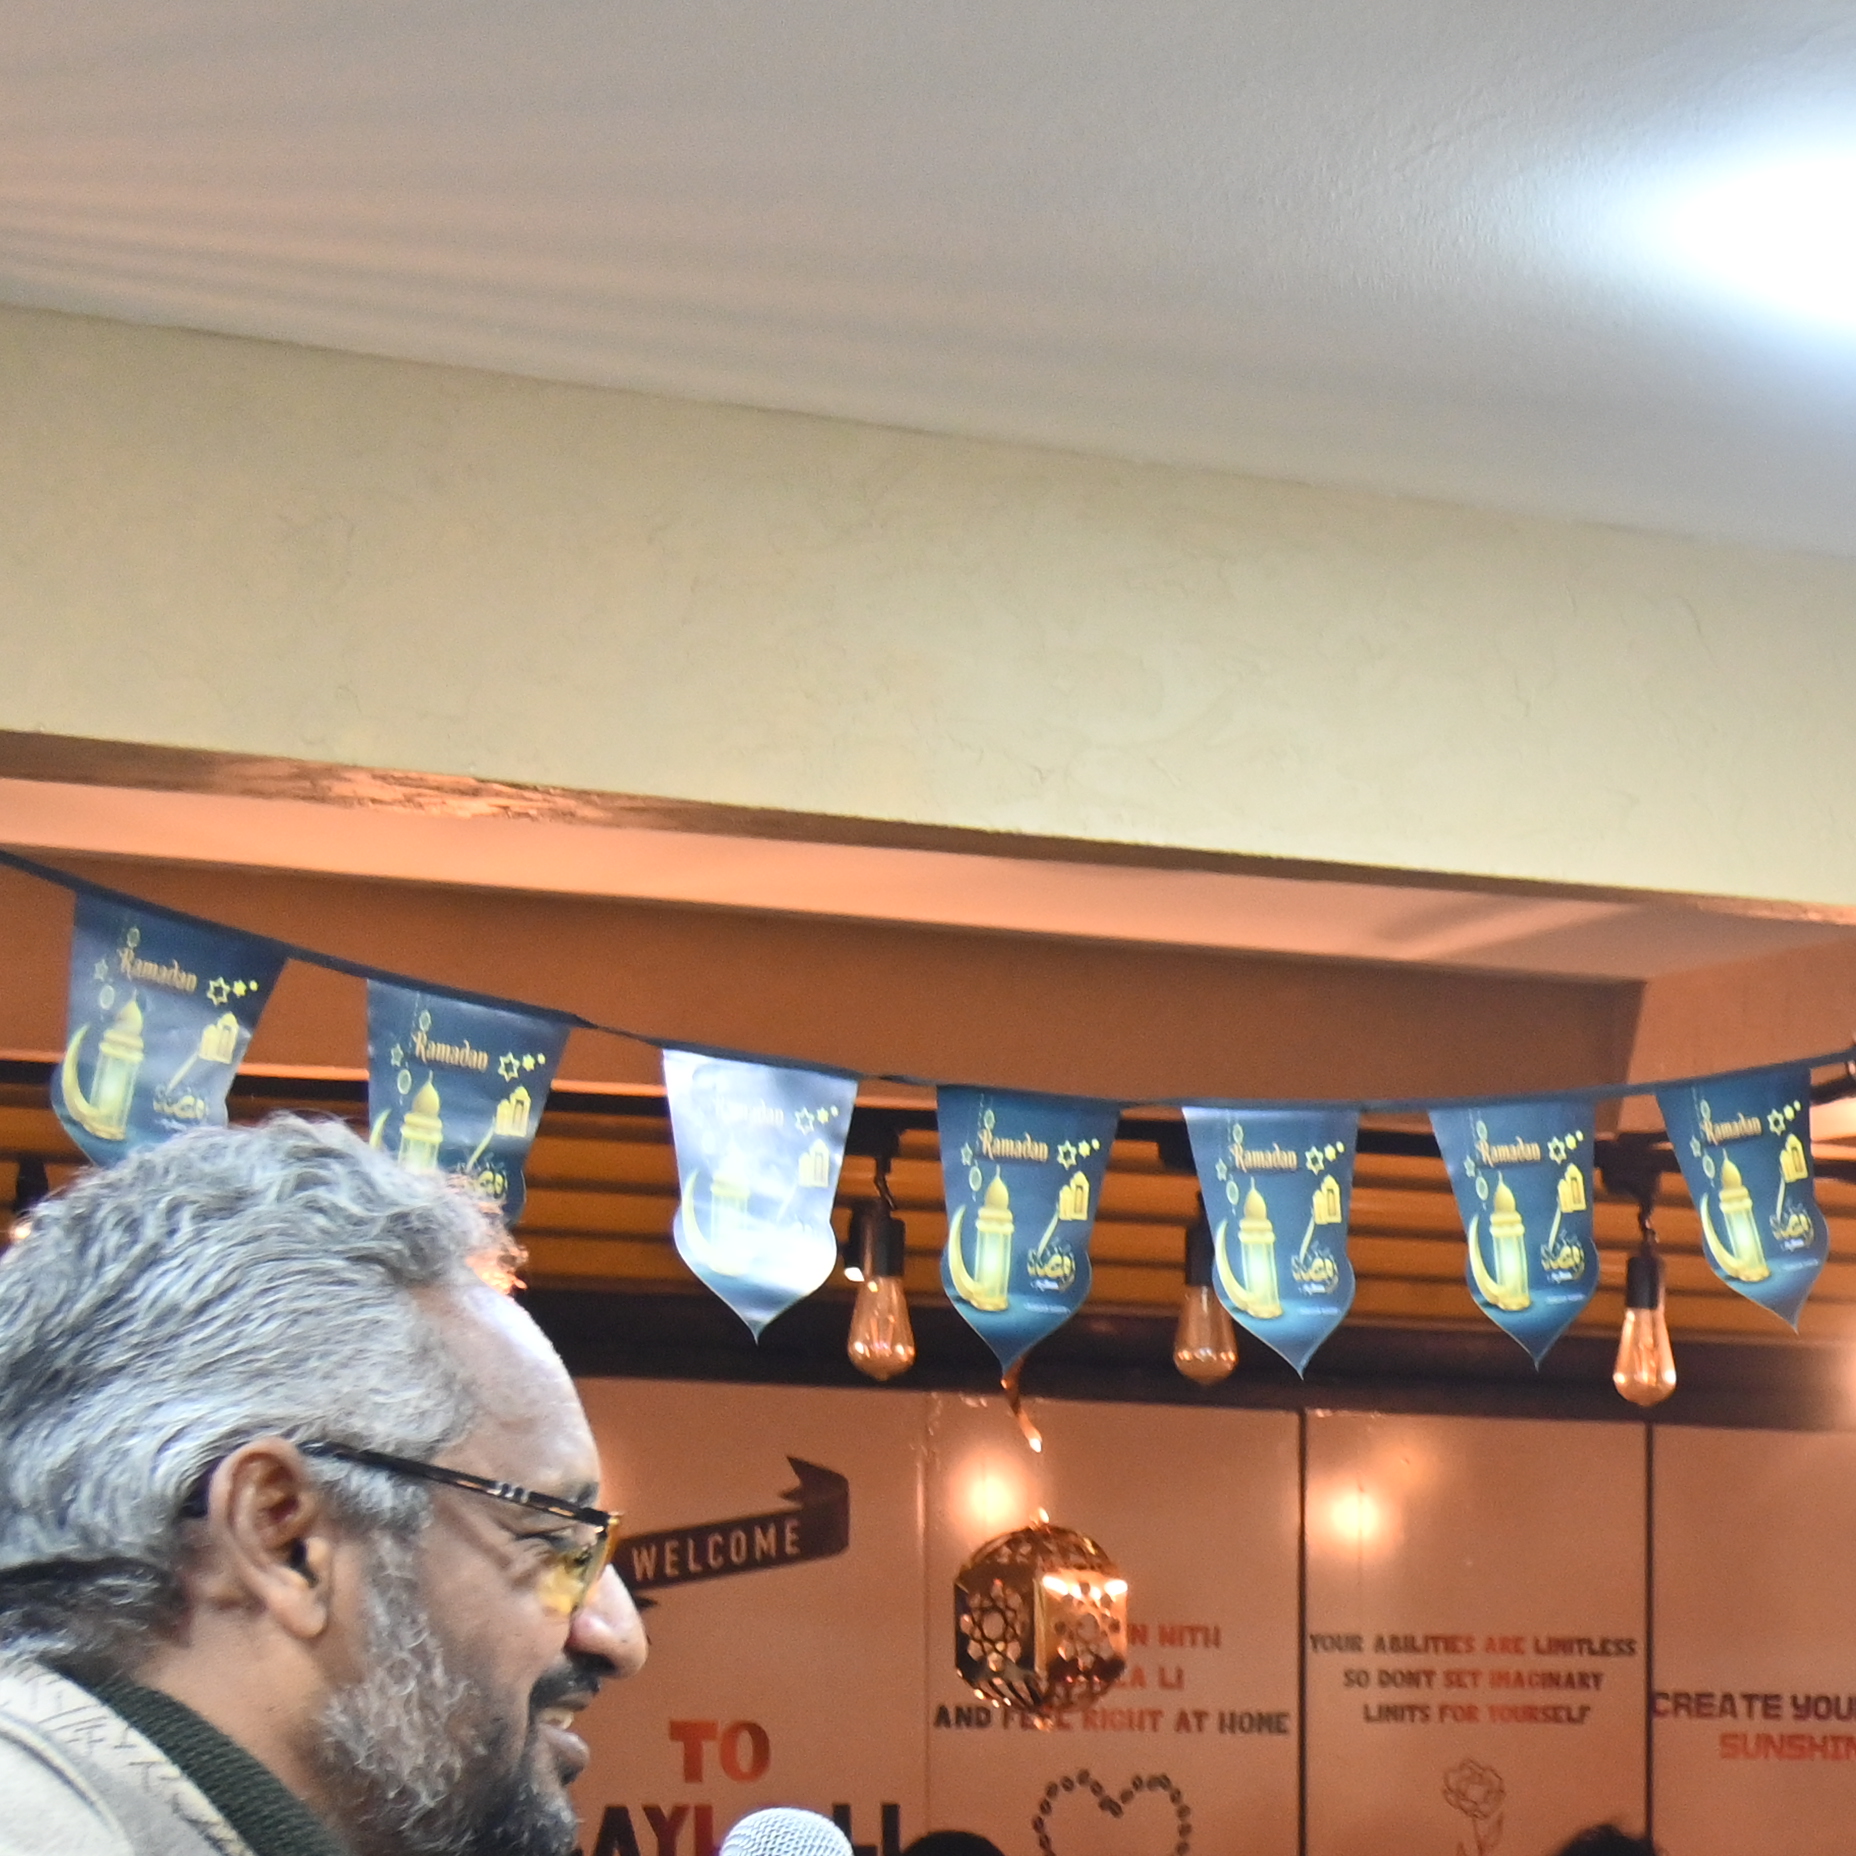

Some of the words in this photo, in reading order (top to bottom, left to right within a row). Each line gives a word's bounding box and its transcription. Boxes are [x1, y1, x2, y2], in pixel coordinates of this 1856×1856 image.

[117, 948, 198, 994] Ramadan
[411, 1031, 489, 1073] Ramadan
[1701, 1112, 1763, 1146] Ramadan
[979, 1129, 1048, 1163] Ramadan
[1228, 1142, 1298, 1173] Ramadan
[1475, 1136, 1541, 1167] Ramadan
[631, 1518, 801, 1582] WELCOME
[1158, 1624, 1221, 1650] WITH
[1309, 1633, 1364, 1654] YOUR
[1374, 1634, 1477, 1655] ABILITIES
[1484, 1634, 1527, 1655] ARE
[1533, 1634, 1638, 1657] LIMITLESS
[1158, 1667, 1186, 1691] LI
[1343, 1669, 1371, 1690] SO
[1442, 1669, 1482, 1690] SET
[933, 1704, 992, 1730] AND
[1081, 1708, 1165, 1733] RIGHT
[1174, 1710, 1210, 1733] AT
[1218, 1711, 1291, 1736] HOME
[1363, 1703, 1430, 1724] LIMITS
[1438, 1704, 1480, 1724] FOR
[1488, 1704, 1592, 1725] YOURSELF
[1651, 1691, 1784, 1721] CREATE
[668, 1720, 772, 1784] TO
